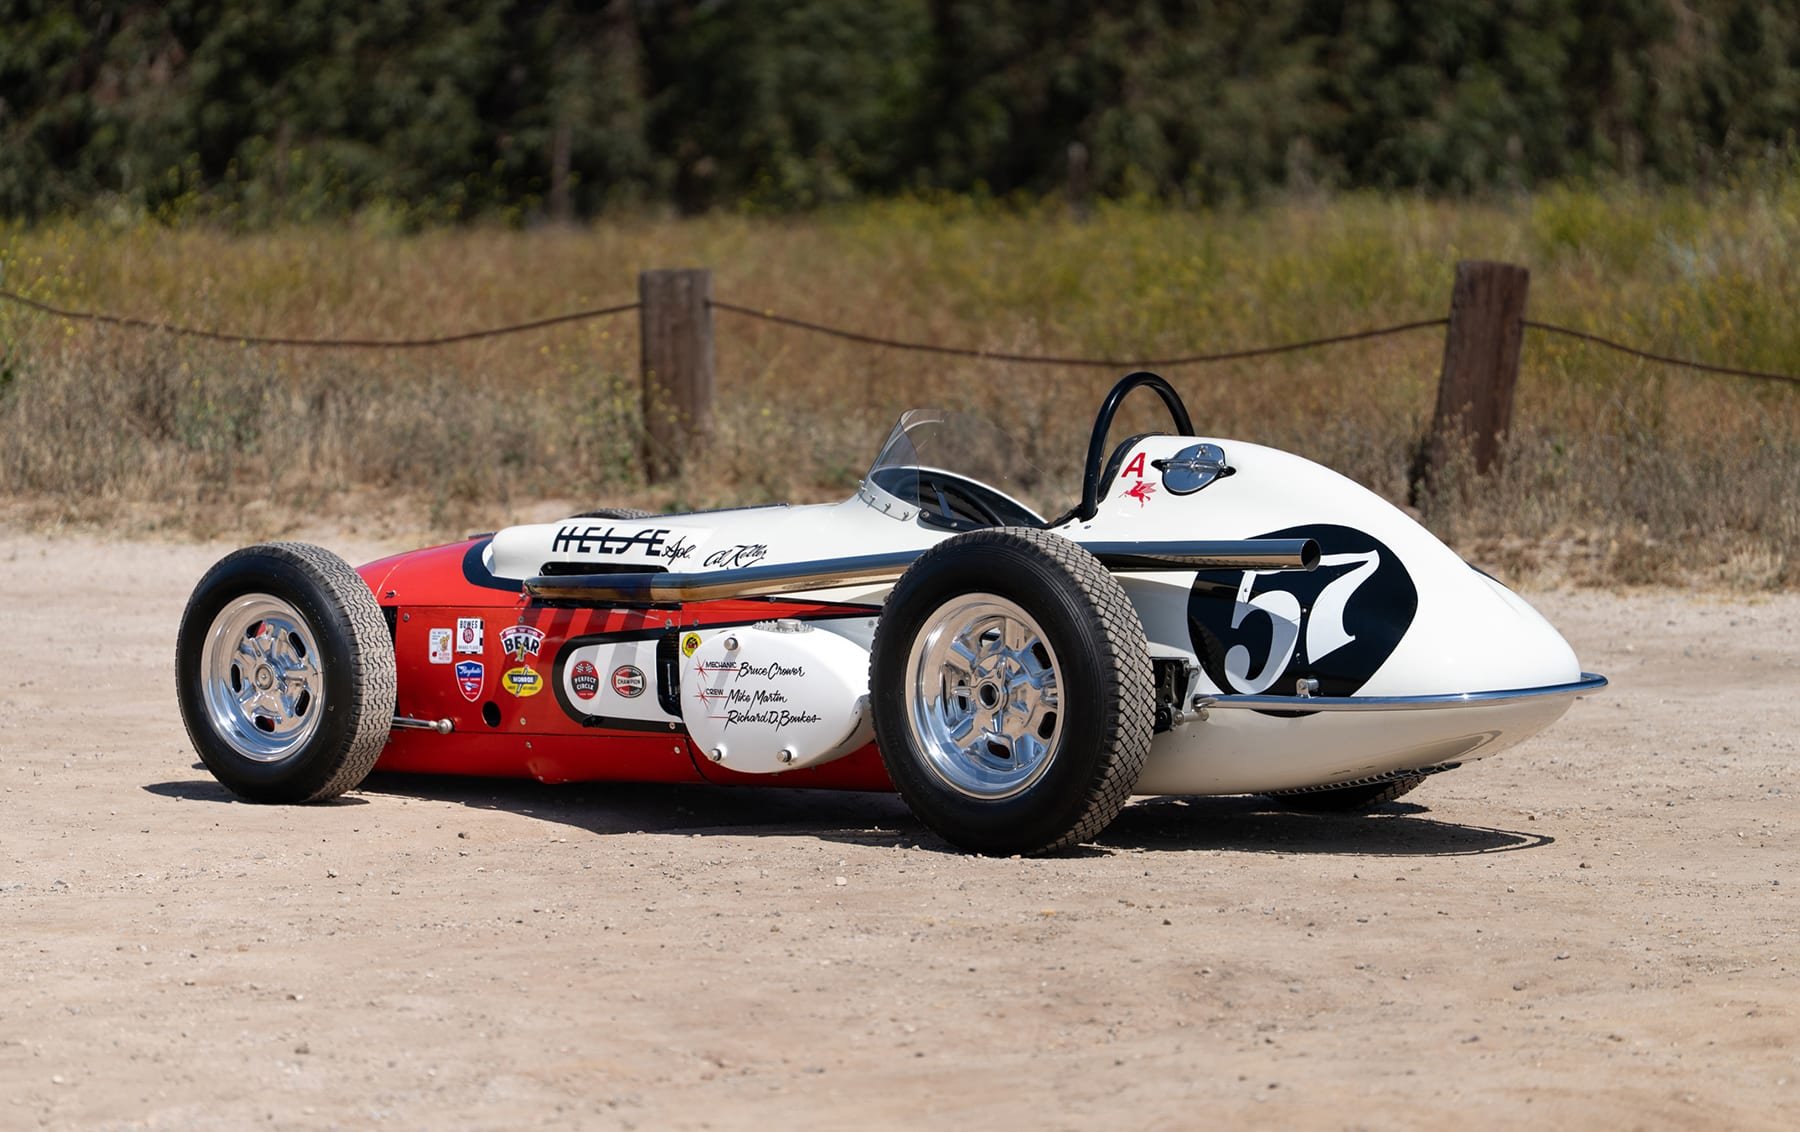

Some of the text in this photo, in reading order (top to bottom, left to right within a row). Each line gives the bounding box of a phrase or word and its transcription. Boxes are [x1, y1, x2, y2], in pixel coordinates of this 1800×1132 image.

[1121, 452, 1146, 478] A
[552, 526, 671, 556] HELSE
[459, 620, 479, 629] BOWES
[1224, 549, 1381, 695] 57
[504, 636, 540, 654] BEAR
[705, 661, 737, 669] MECHANIC
[735, 662, 768, 682] Bruce
[574, 676, 596, 684] PERFECT
[705, 688, 724, 696] CREW
[723, 689, 788, 711] Mike Martin
[724, 709, 769, 732] Richard
